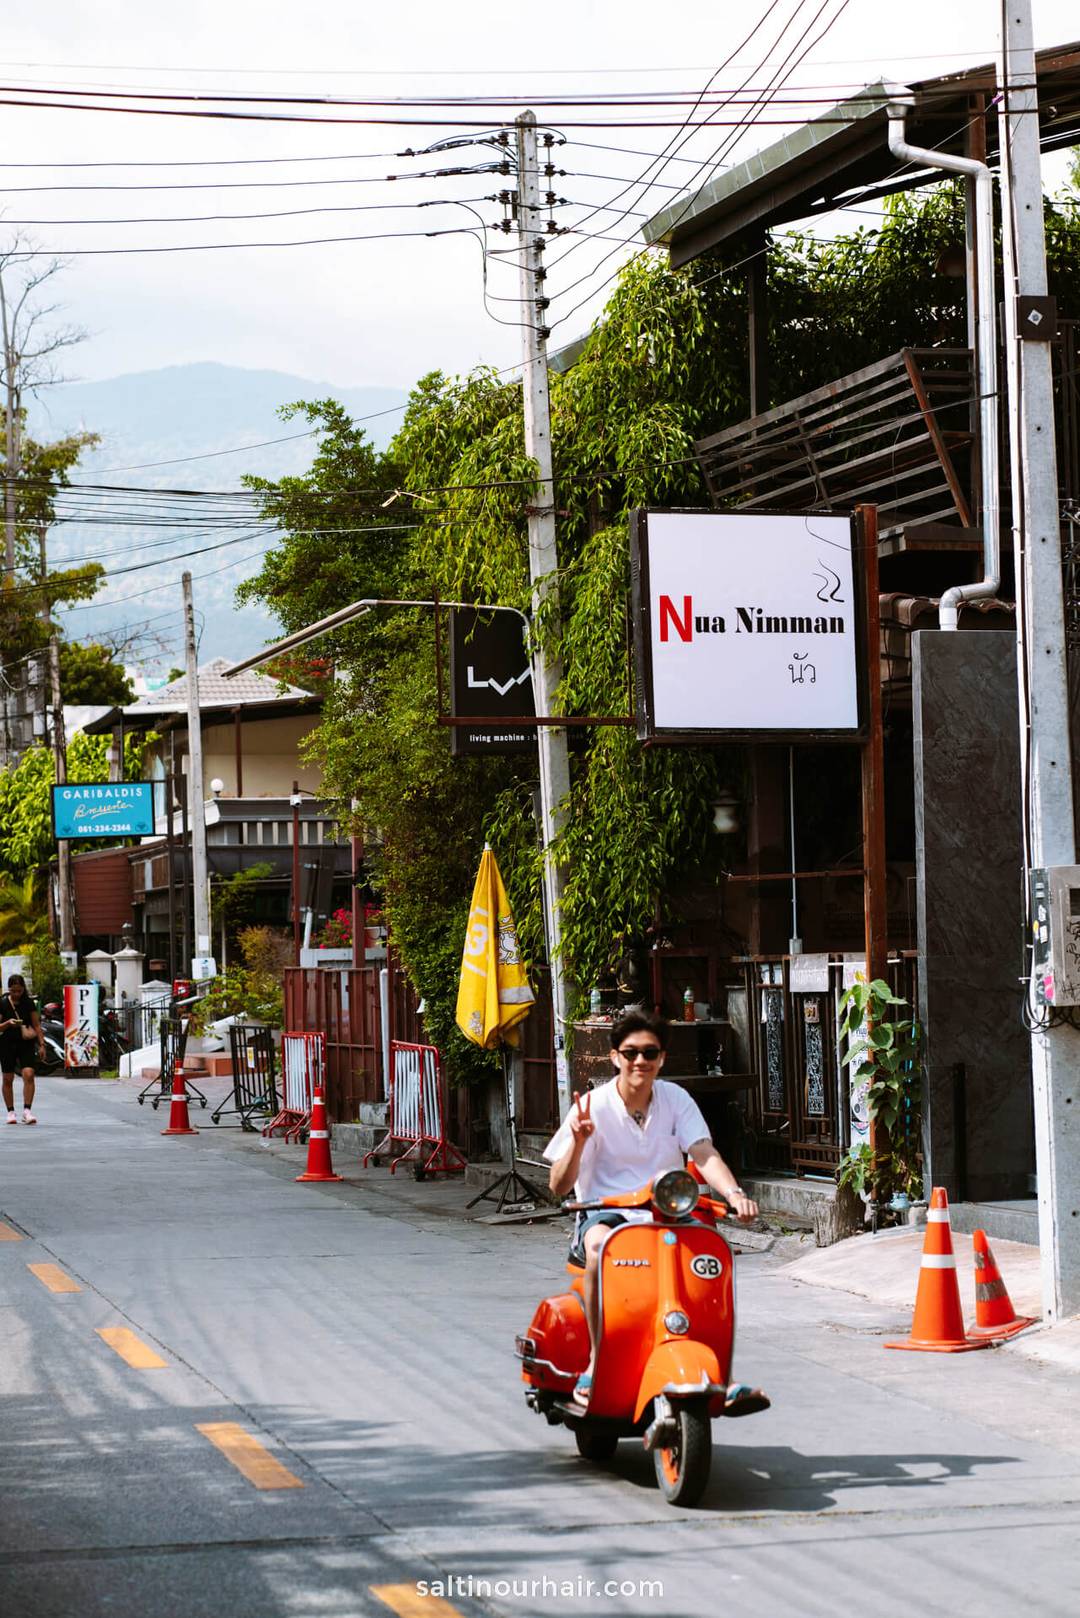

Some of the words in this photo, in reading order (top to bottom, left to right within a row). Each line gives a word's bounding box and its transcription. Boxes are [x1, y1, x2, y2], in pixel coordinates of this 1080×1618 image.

[659, 595, 726, 642] Nua
[735, 607, 846, 634] Nimman
[788, 652, 816, 684] นัว
[469, 734, 492, 743] living
[494, 733, 525, 742] machine
[63, 788, 143, 799] GARIBALDIS
[79, 989, 91, 1061] PIZZA
[694, 1258, 719, 1275] GB
